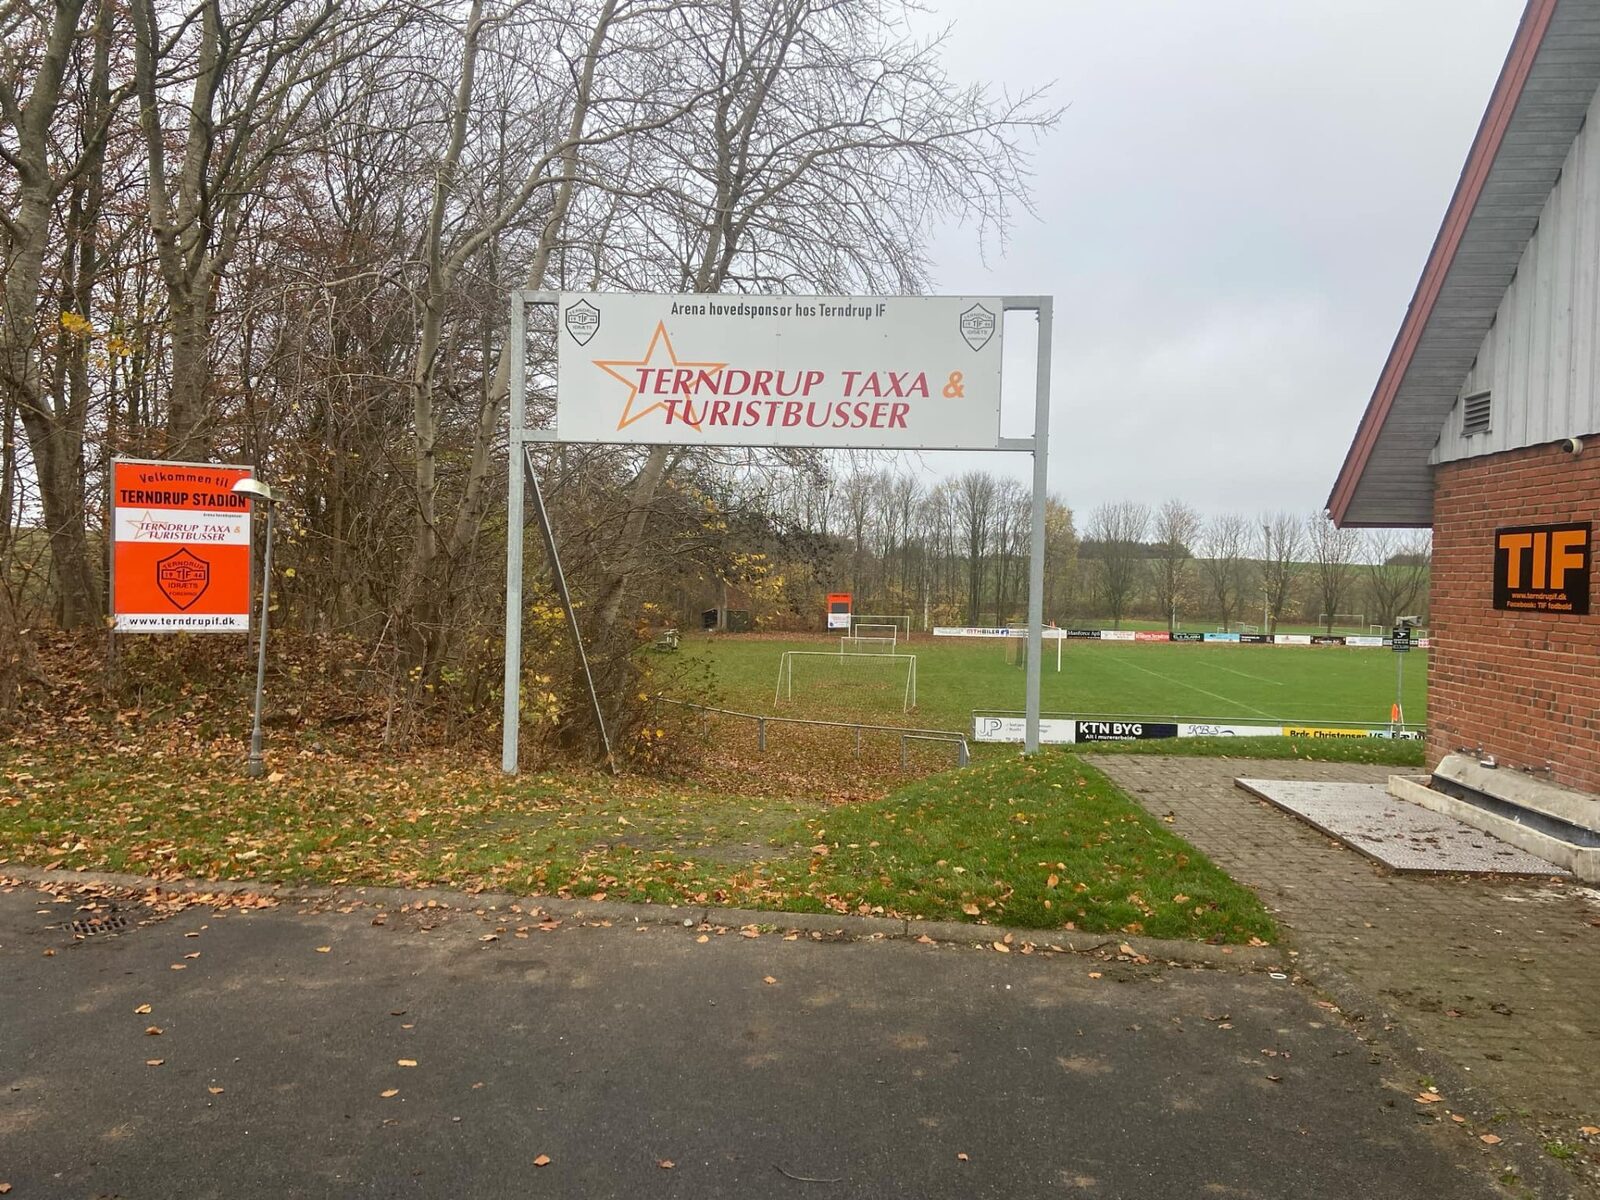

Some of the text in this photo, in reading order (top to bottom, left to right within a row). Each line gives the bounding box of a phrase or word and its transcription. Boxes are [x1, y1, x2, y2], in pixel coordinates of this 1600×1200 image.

[671, 301, 887, 321] Arena hovedsponsor hos Terndrup IF
[636, 368, 965, 399] TERNDRUP TAXA &
[663, 399, 910, 430] TURISTBUSSER
[139, 472, 229, 488] Velkommen til
[120, 489, 247, 508] TERNDRUP STADION
[139, 522, 241, 534] TERNDRUP TAXA &
[148, 530, 226, 541] TURISTBUSSER
[162, 560, 205, 570] TERNDRUP
[1499, 529, 1587, 590] TIF
[176, 568, 191, 580] TIF
[1511, 592, 1567, 601] www.terndrupif.dk
[1537, 601, 1548, 609] TIF
[129, 616, 236, 627] www.terndrupif.dk
[977, 718, 1002, 737] JP
[1079, 722, 1143, 736] KTN BYG
[1313, 731, 1367, 739] Christensen
